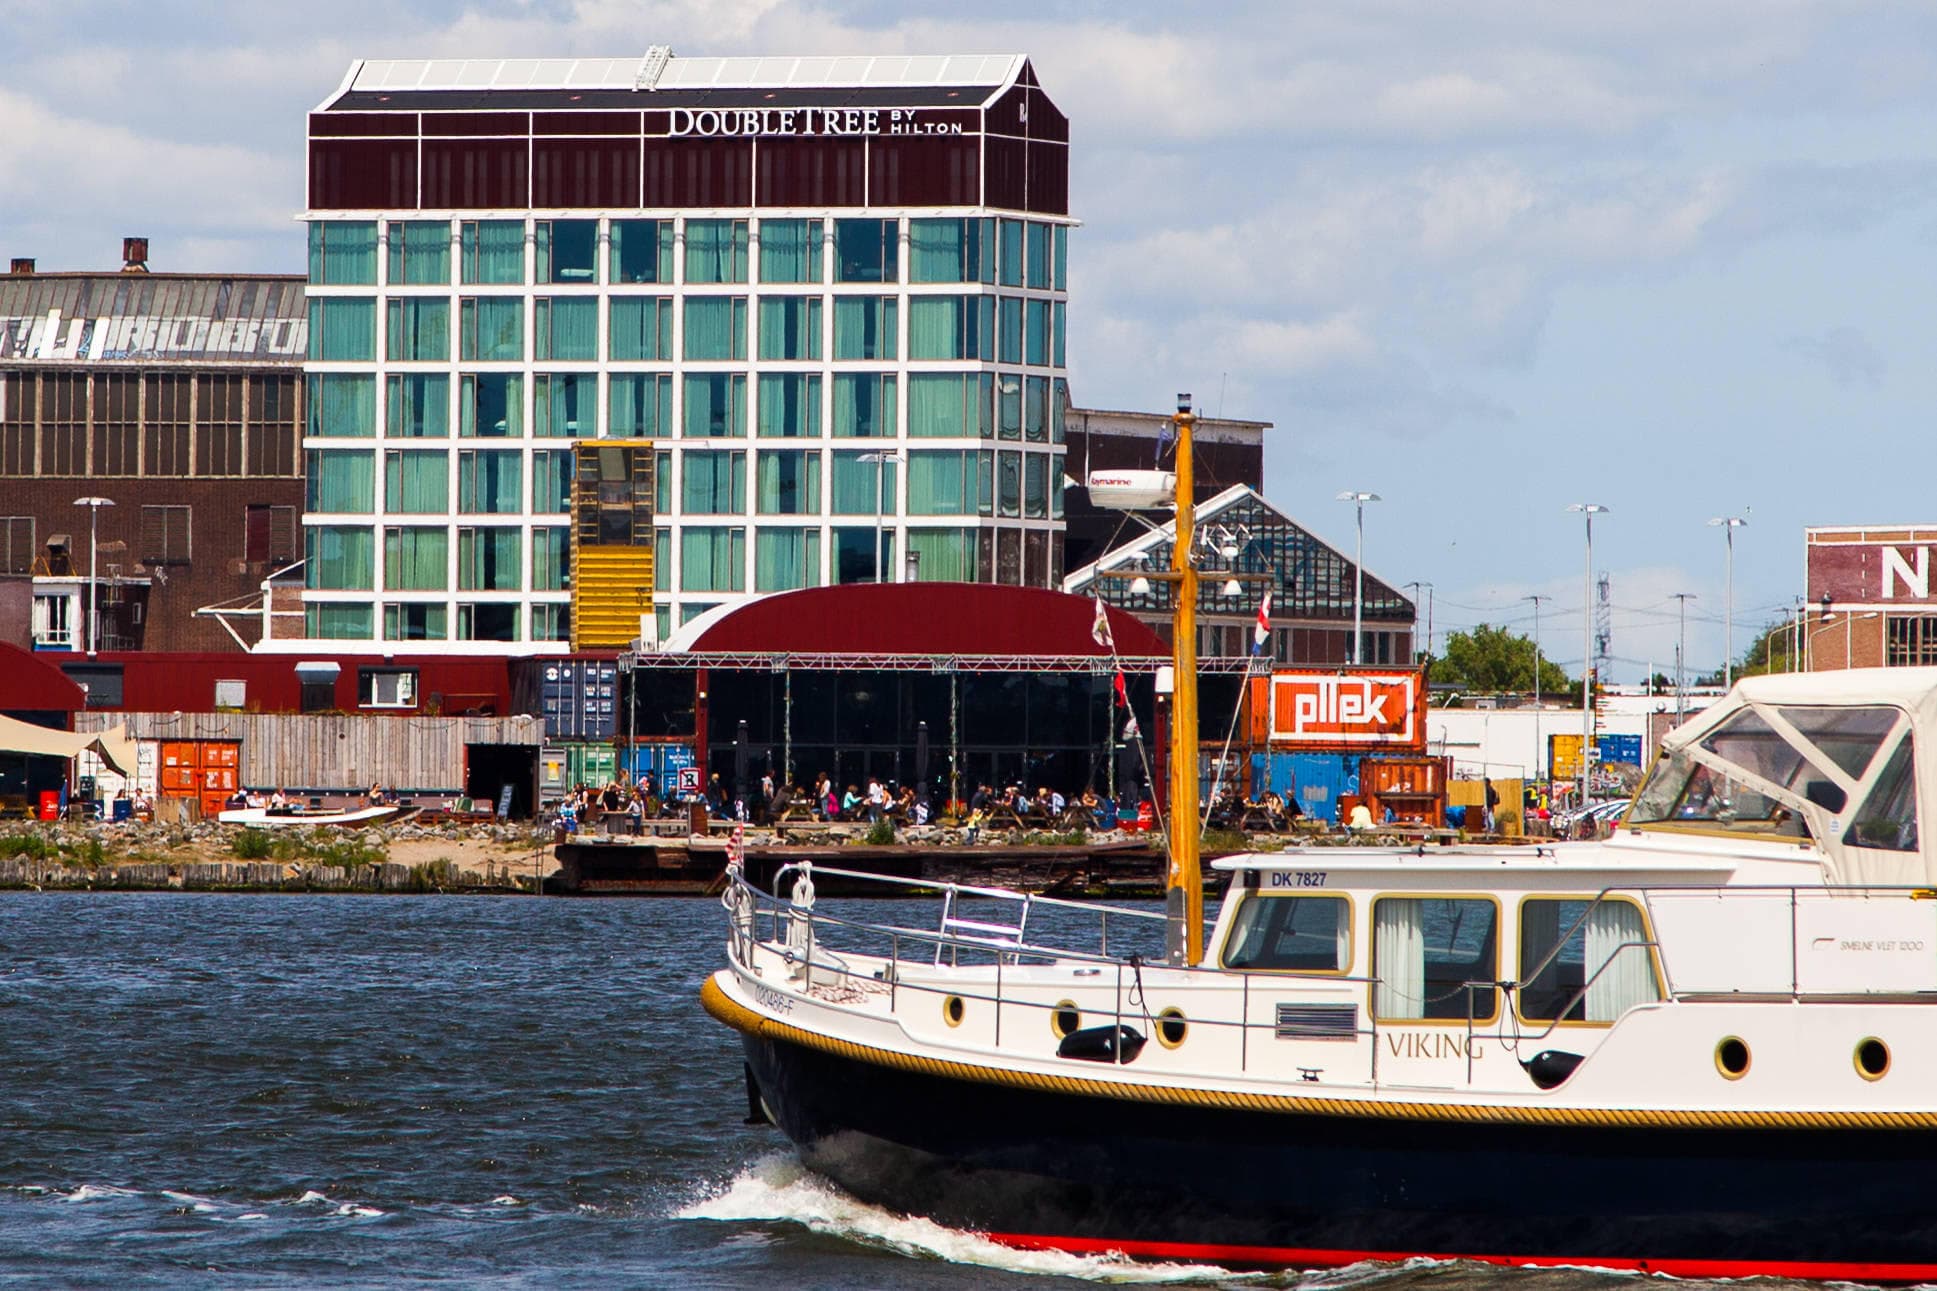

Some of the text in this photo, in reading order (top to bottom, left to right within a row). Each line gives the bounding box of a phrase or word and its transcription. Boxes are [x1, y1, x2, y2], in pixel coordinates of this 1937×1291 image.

[669, 107, 881, 136] DOUBLETREE
[890, 110, 916, 121] BY
[890, 123, 962, 134] HILTON
[1881, 545, 1929, 599] N
[1295, 683, 1388, 733] pllek
[1271, 872, 1328, 887] DK 7827
[1386, 1032, 1483, 1060] VIKING
